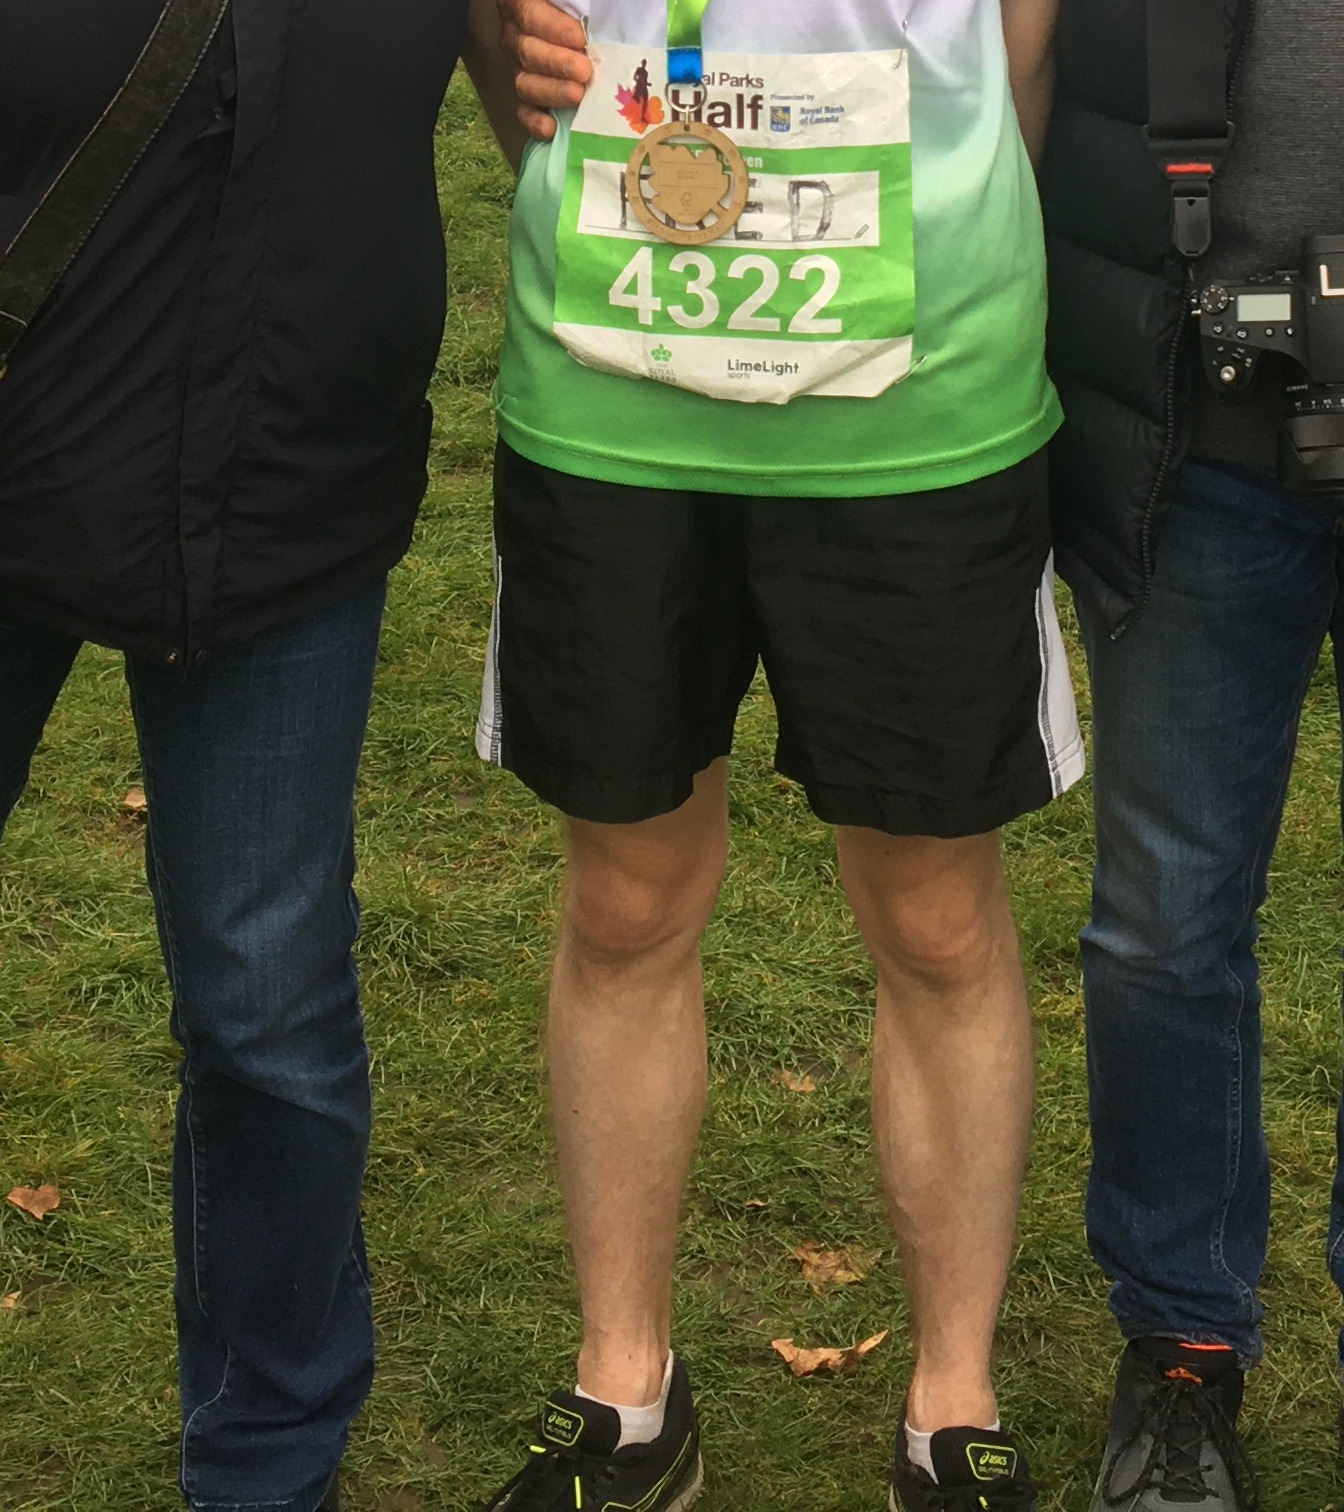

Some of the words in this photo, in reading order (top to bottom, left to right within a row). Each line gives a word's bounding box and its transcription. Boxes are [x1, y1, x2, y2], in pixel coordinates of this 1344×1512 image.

[719, 72, 765, 89] Parks
[671, 89, 764, 131] Half
[799, 106, 823, 116] Royal
[824, 105, 845, 114] Bank
[809, 116, 840, 125] Canada
[608, 246, 842, 333] 4322
[727, 359, 800, 376] LimeLight
